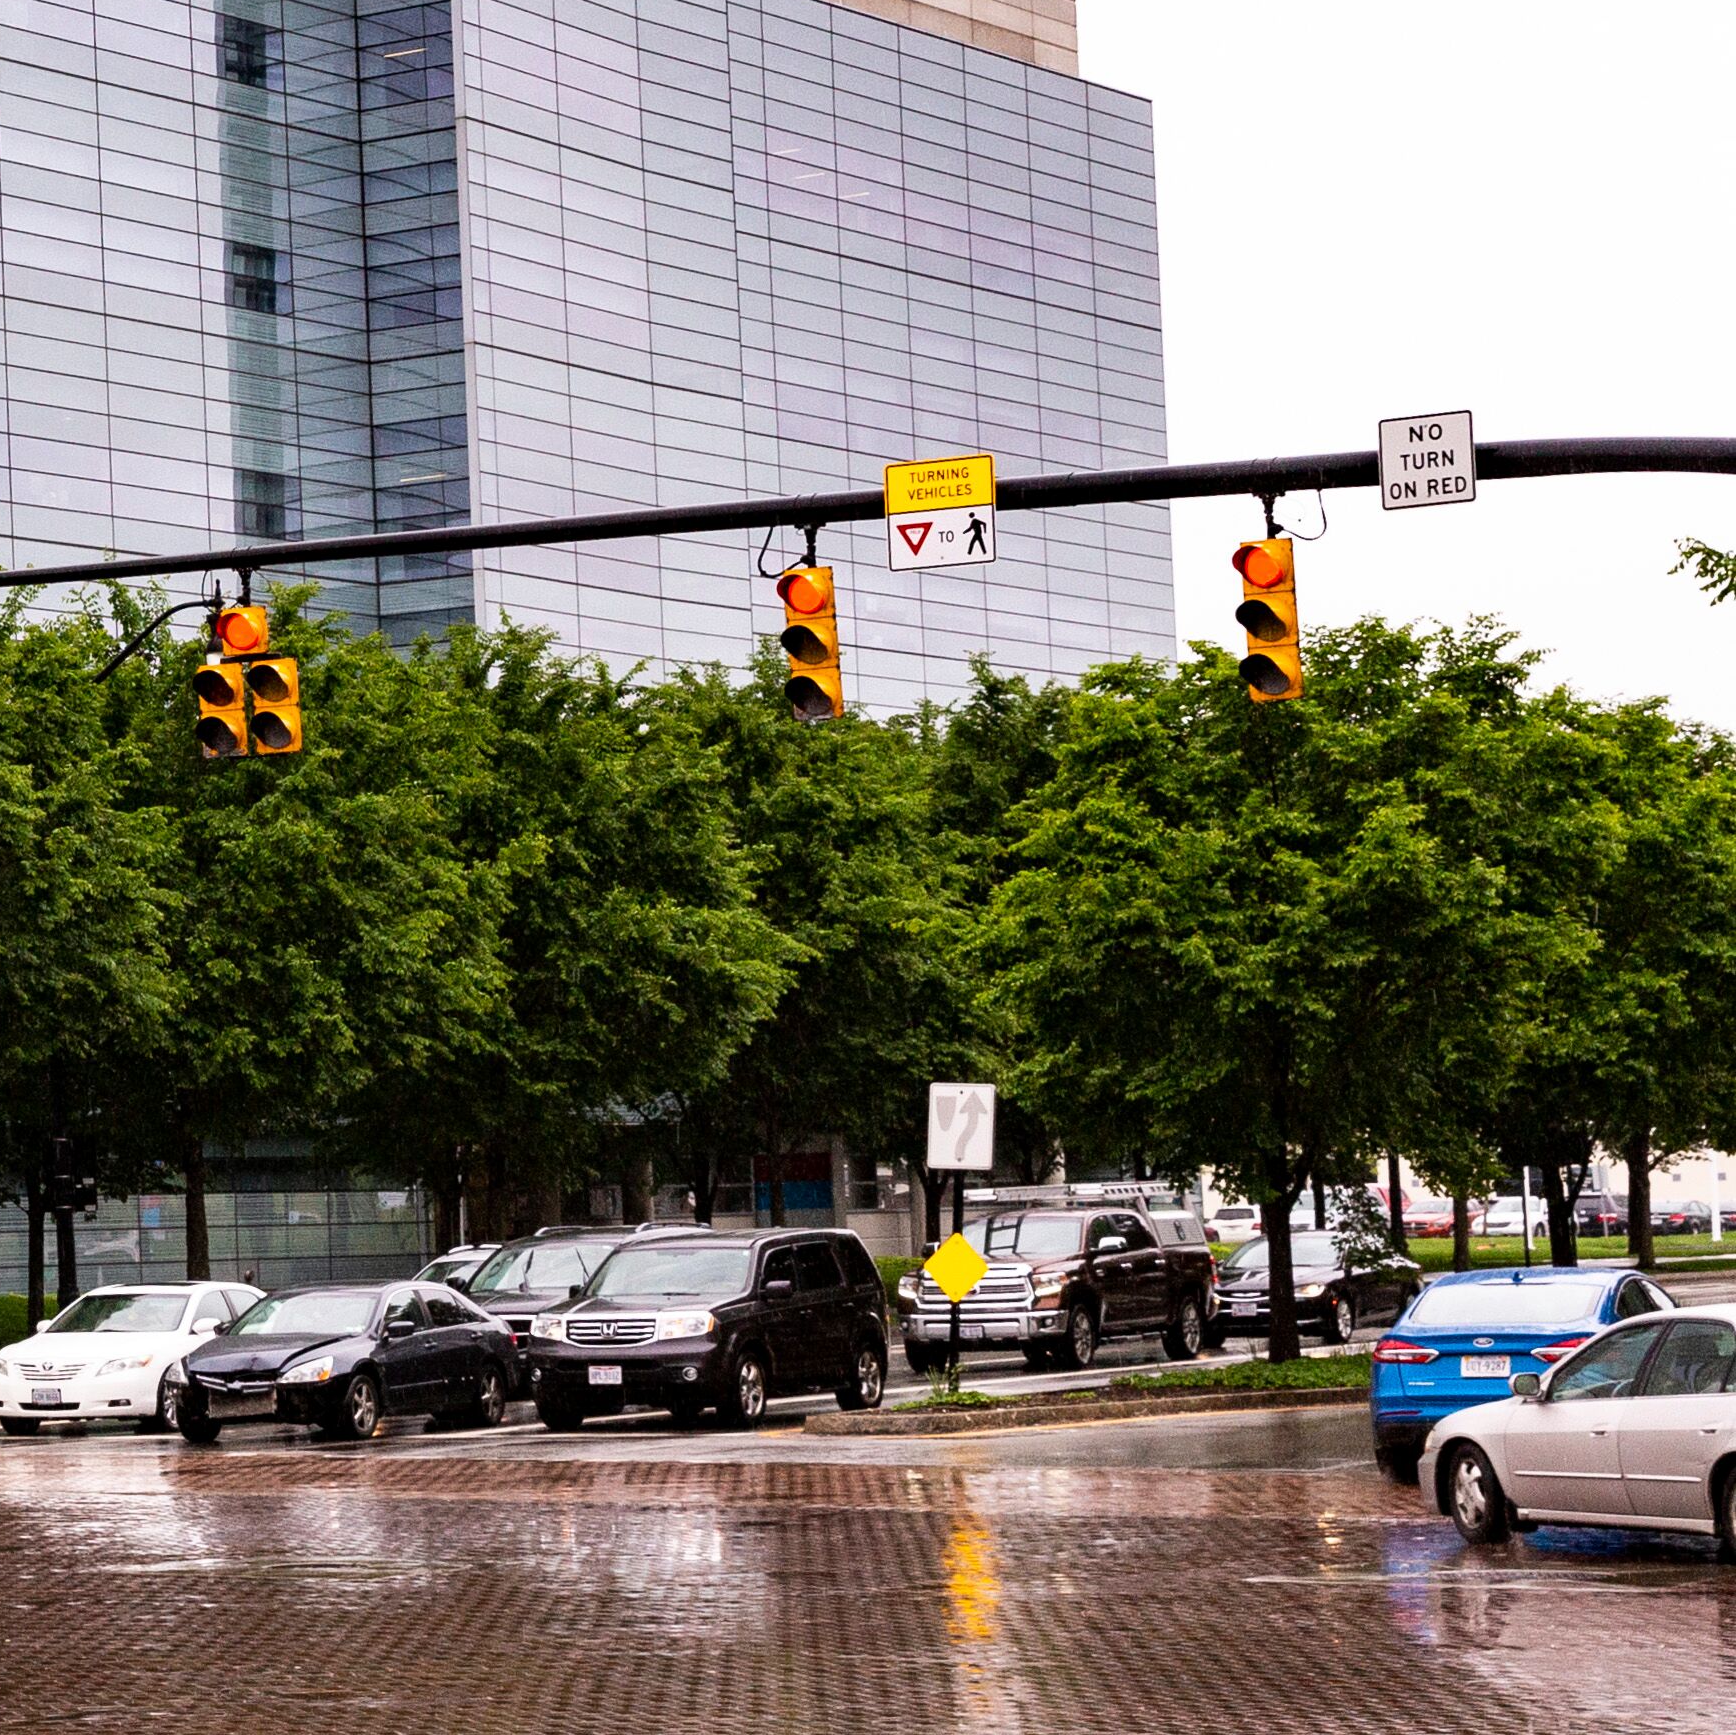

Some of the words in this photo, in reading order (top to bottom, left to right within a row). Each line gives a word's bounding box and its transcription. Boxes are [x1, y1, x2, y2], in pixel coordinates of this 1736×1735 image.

[1409, 424, 1442, 442] NO
[1400, 449, 1454, 471] TURN
[909, 467, 969, 483] TURNING
[907, 484, 972, 500] VEHICLES
[1390, 481, 1417, 500] ON
[1427, 476, 1467, 497] RED
[938, 530, 955, 543] TO
